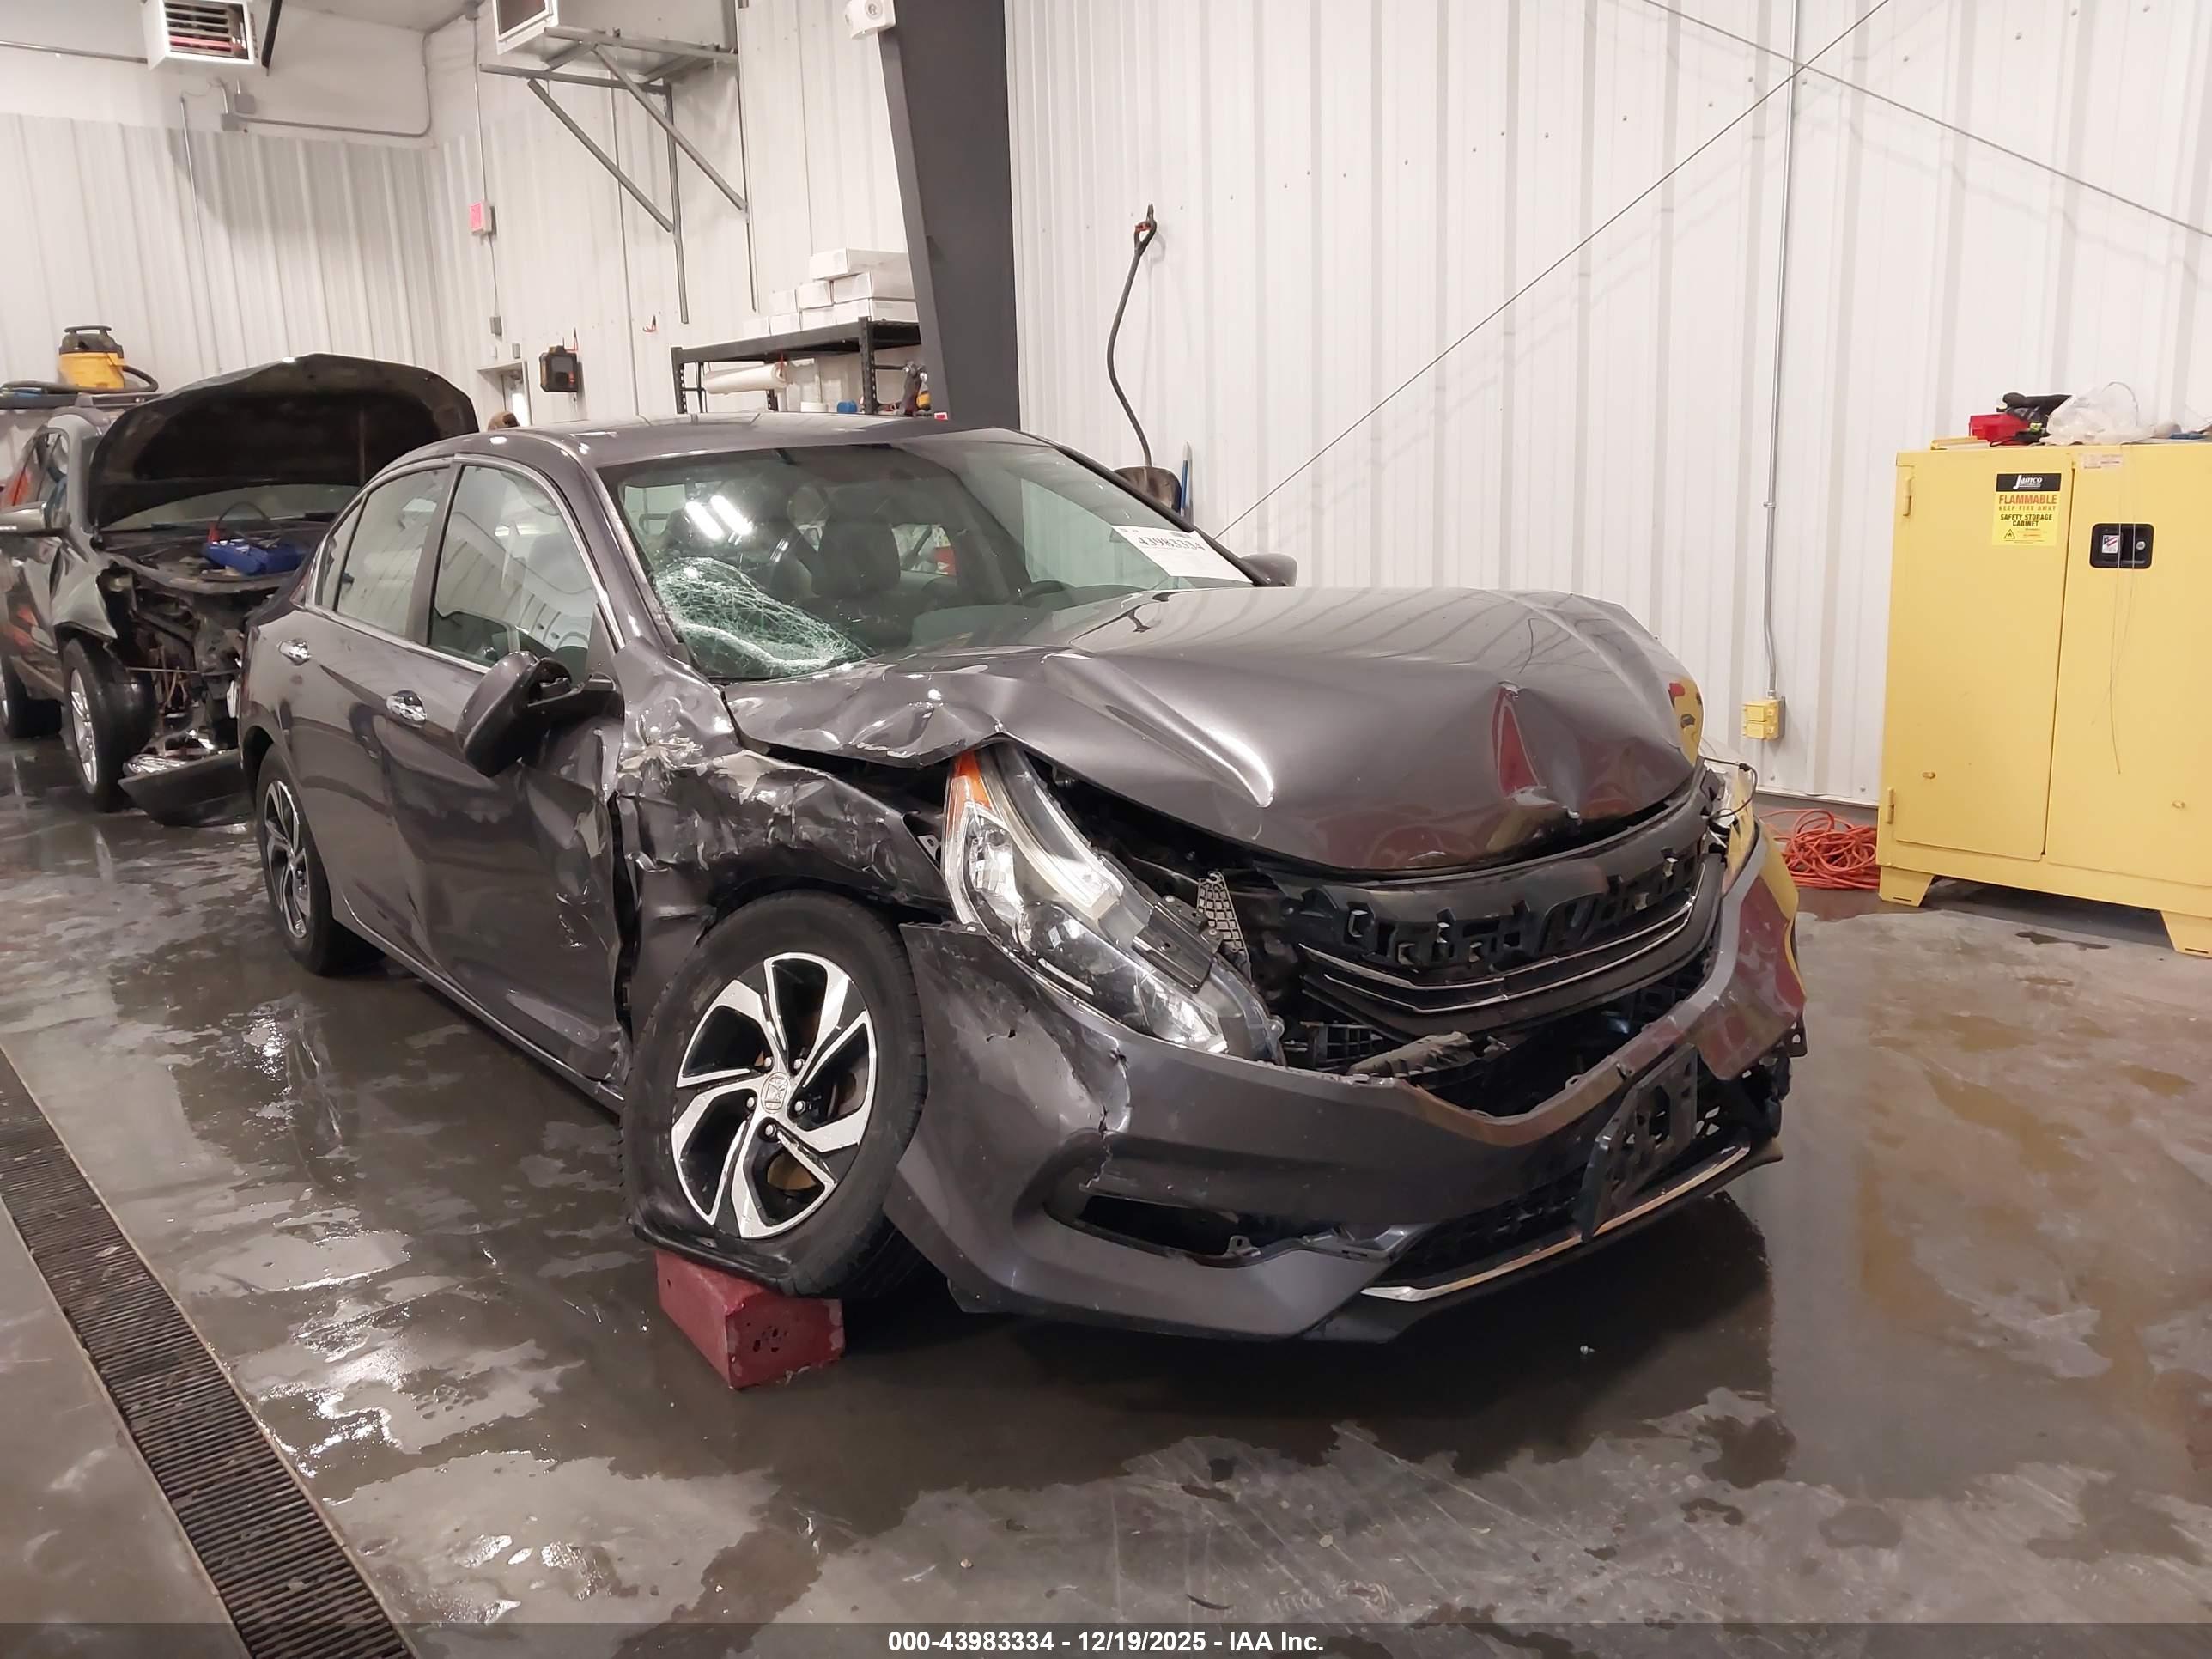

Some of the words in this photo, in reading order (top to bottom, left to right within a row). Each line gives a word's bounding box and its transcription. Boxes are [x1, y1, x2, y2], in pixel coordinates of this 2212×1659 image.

[2013, 475, 2043, 489] Jamco
[1999, 495, 2057, 504] FLAMMABLE
[1139, 537, 1206, 550] 43983334
